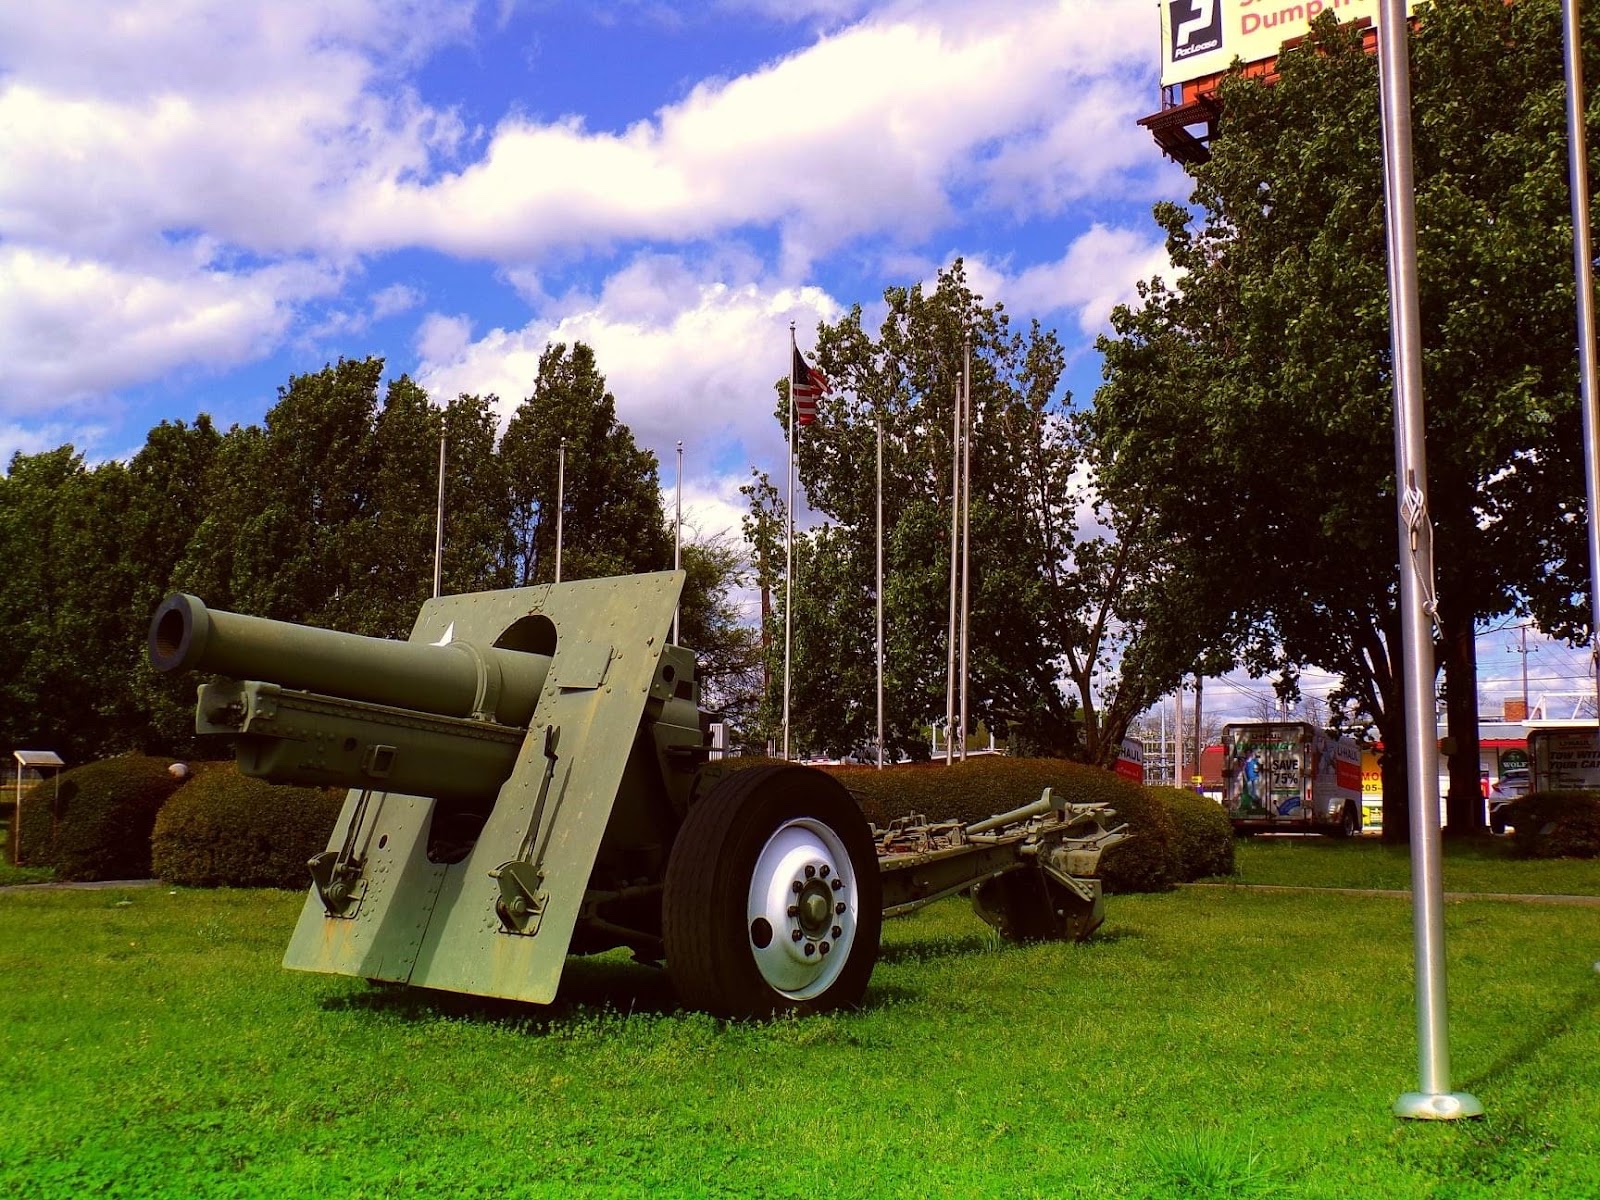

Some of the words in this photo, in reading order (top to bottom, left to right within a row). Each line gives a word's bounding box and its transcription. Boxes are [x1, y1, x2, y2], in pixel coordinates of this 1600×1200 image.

[1241, 0, 1323, 35] Dump
[1174, 39, 1218, 59] PacLease
[1118, 747, 1141, 762] HAUL
[1272, 760, 1299, 770] SAVE
[1273, 773, 1299, 784] 75%
